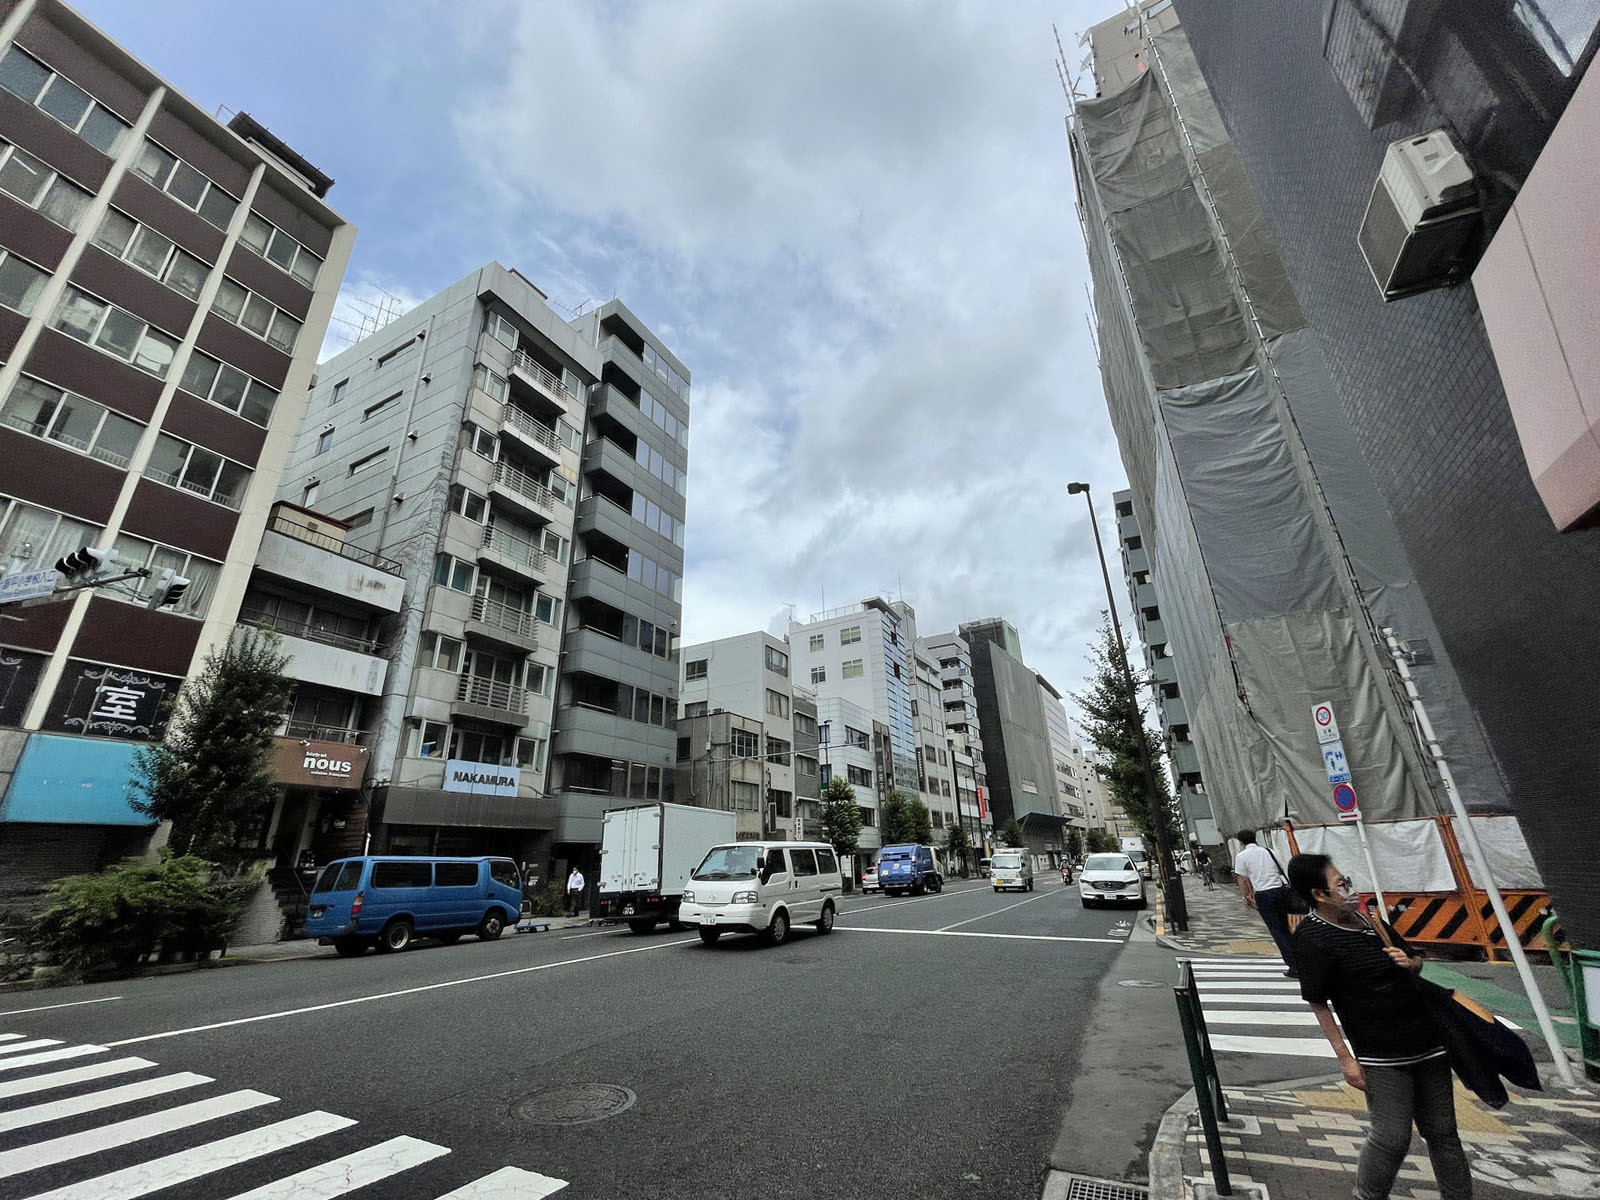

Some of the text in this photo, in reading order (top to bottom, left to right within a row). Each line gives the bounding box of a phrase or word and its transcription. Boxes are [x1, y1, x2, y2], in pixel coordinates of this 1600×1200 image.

[92, 685, 146, 721] 室
[1319, 711, 1329, 721] 30
[303, 757, 352, 772] nous
[453, 771, 515, 787] NAKAMURA
